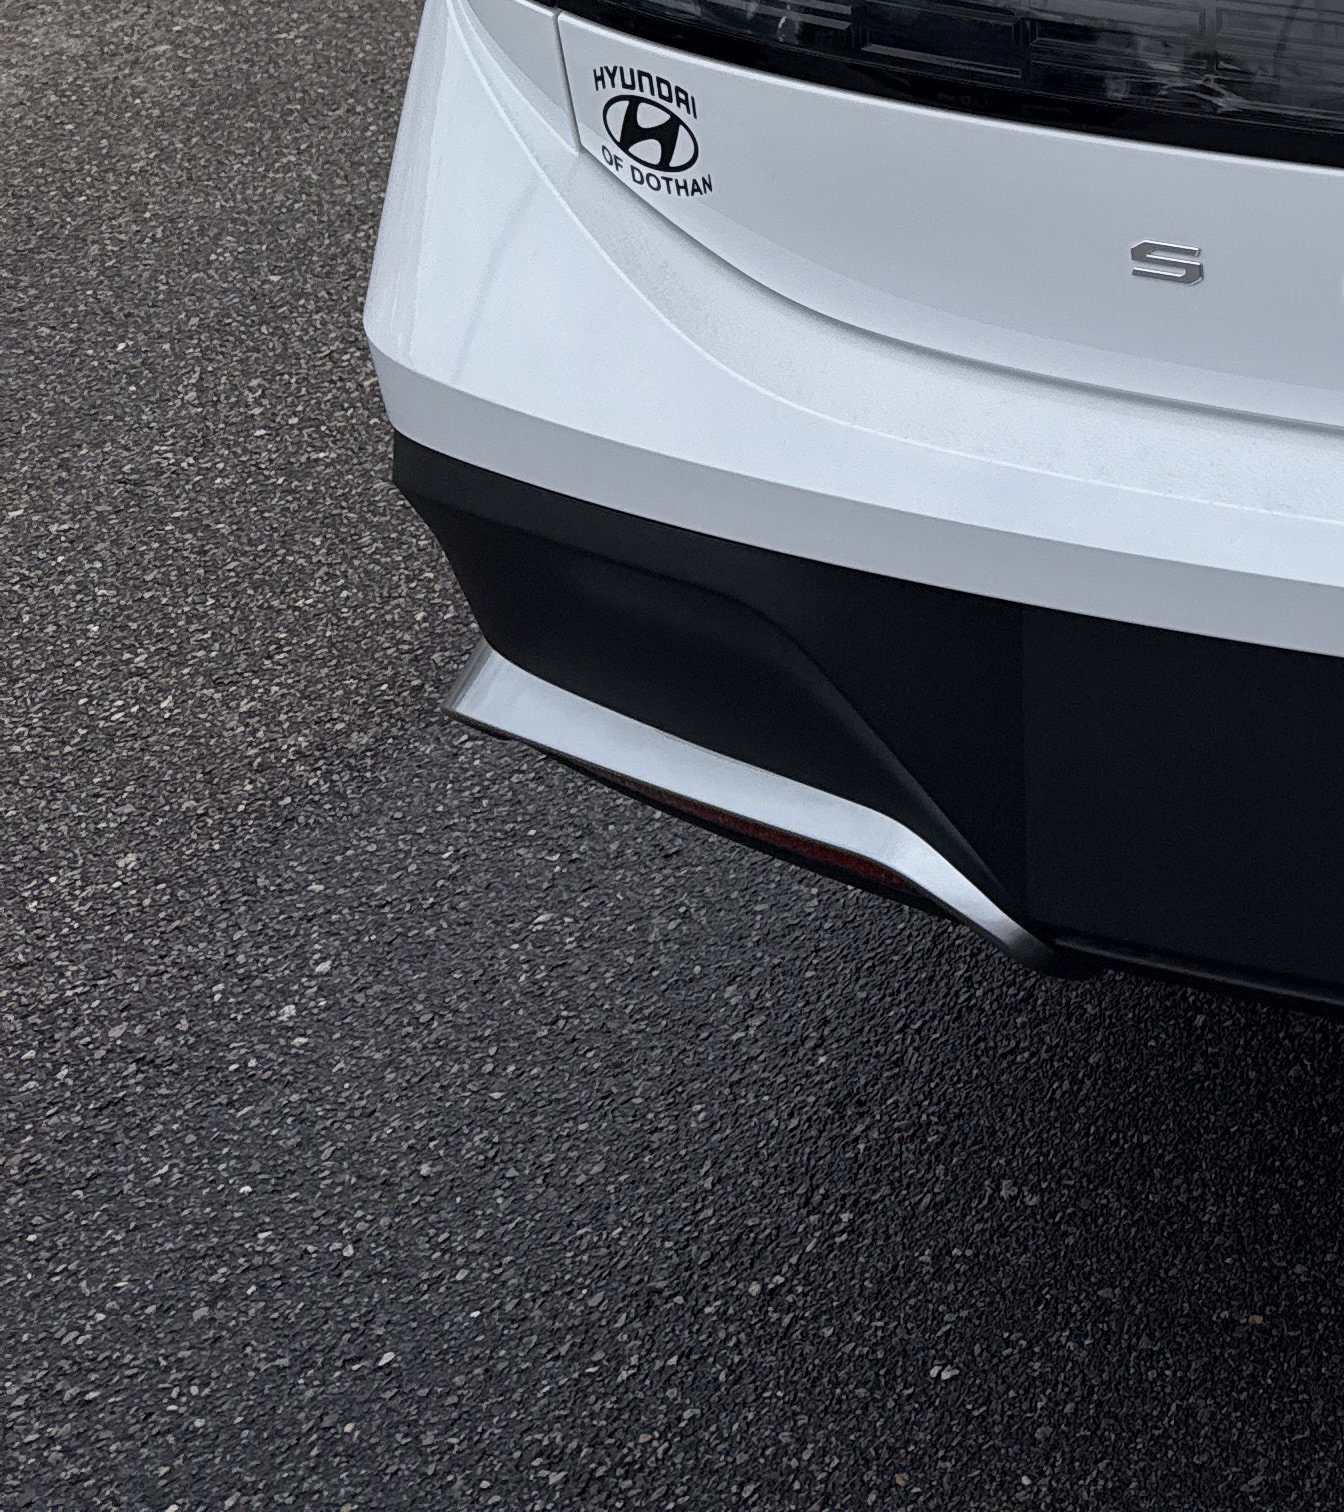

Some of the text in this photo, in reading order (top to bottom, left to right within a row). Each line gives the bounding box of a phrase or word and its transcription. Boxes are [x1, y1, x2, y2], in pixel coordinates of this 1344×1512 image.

[593, 65, 698, 119] HYUNDAI
[601, 144, 713, 197] OF DOTHAN
